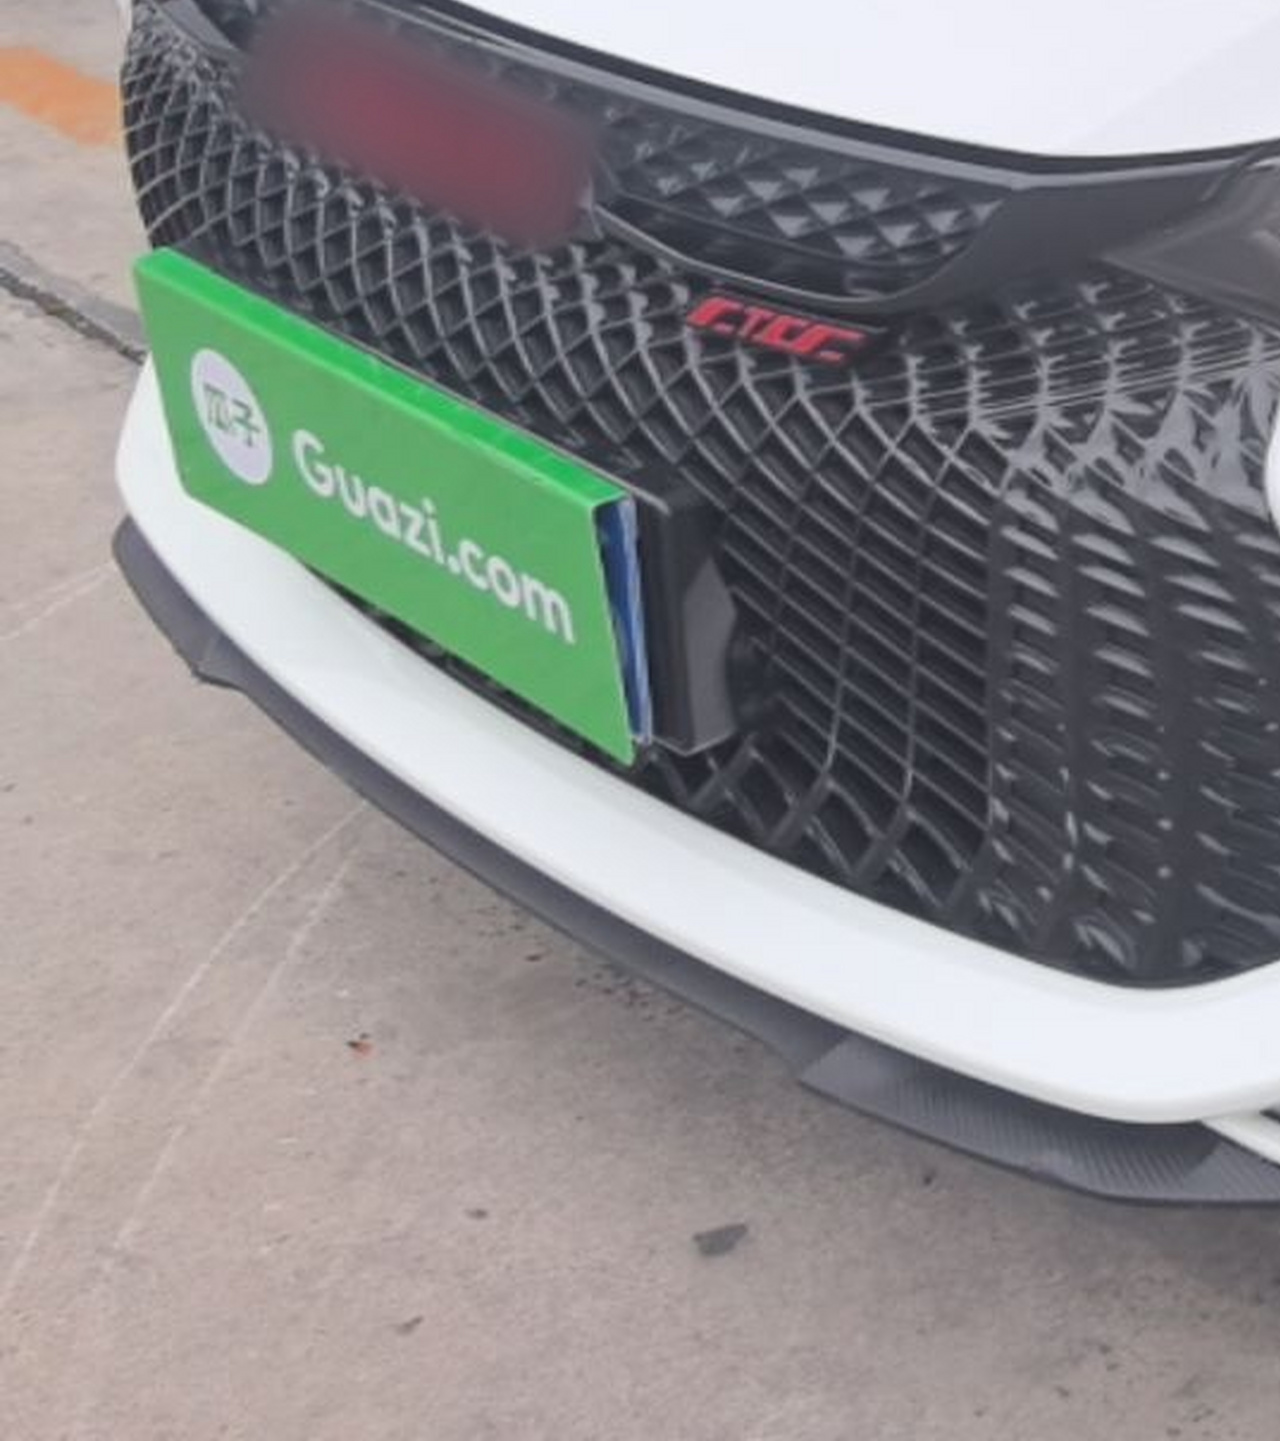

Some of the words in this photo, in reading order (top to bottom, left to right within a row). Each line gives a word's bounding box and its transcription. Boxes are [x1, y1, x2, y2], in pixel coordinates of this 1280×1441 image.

[687, 295, 868, 364] CTCC
[202, 382, 261, 448] 瓜子
[291, 427, 579, 645] Guazi.com
